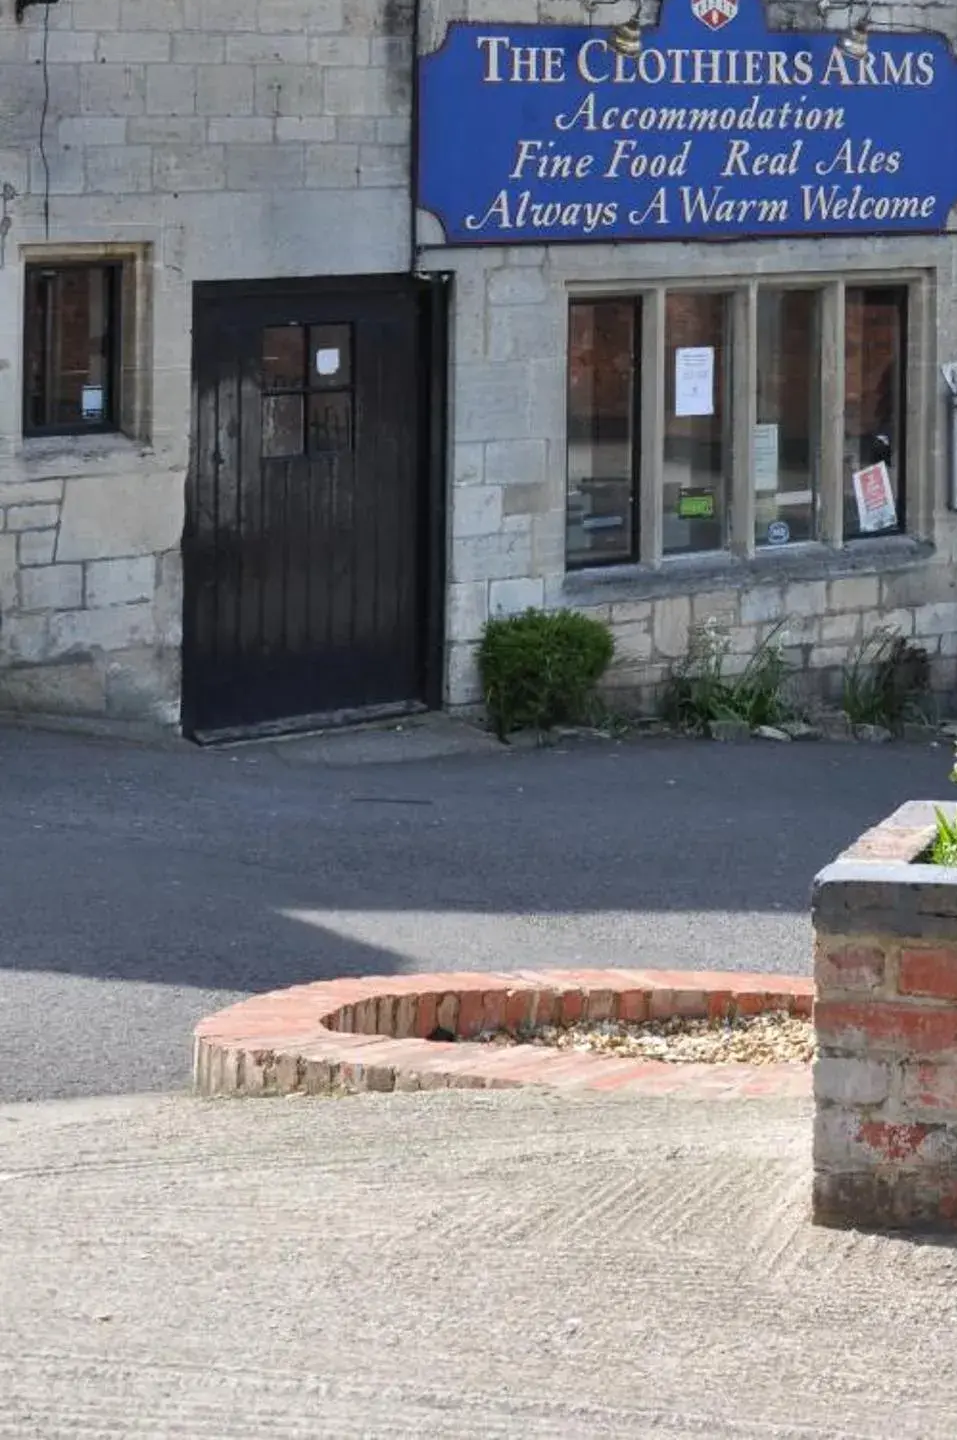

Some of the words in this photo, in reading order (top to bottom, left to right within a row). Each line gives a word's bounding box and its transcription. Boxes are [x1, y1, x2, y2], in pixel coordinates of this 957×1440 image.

[476, 35, 566, 83] THE
[576, 38, 813, 86] CLOTHIERS
[818, 44, 935, 86] ARMS
[554, 91, 845, 131] Accommodation
[507, 140, 594, 179] Fine
[602, 139, 690, 178] Food
[719, 138, 803, 177] Real
[814, 137, 902, 176] Ales
[464, 189, 619, 233] Always
[628, 186, 670, 225] A
[676, 185, 789, 224] Warm
[799, 183, 937, 222] Welcome
